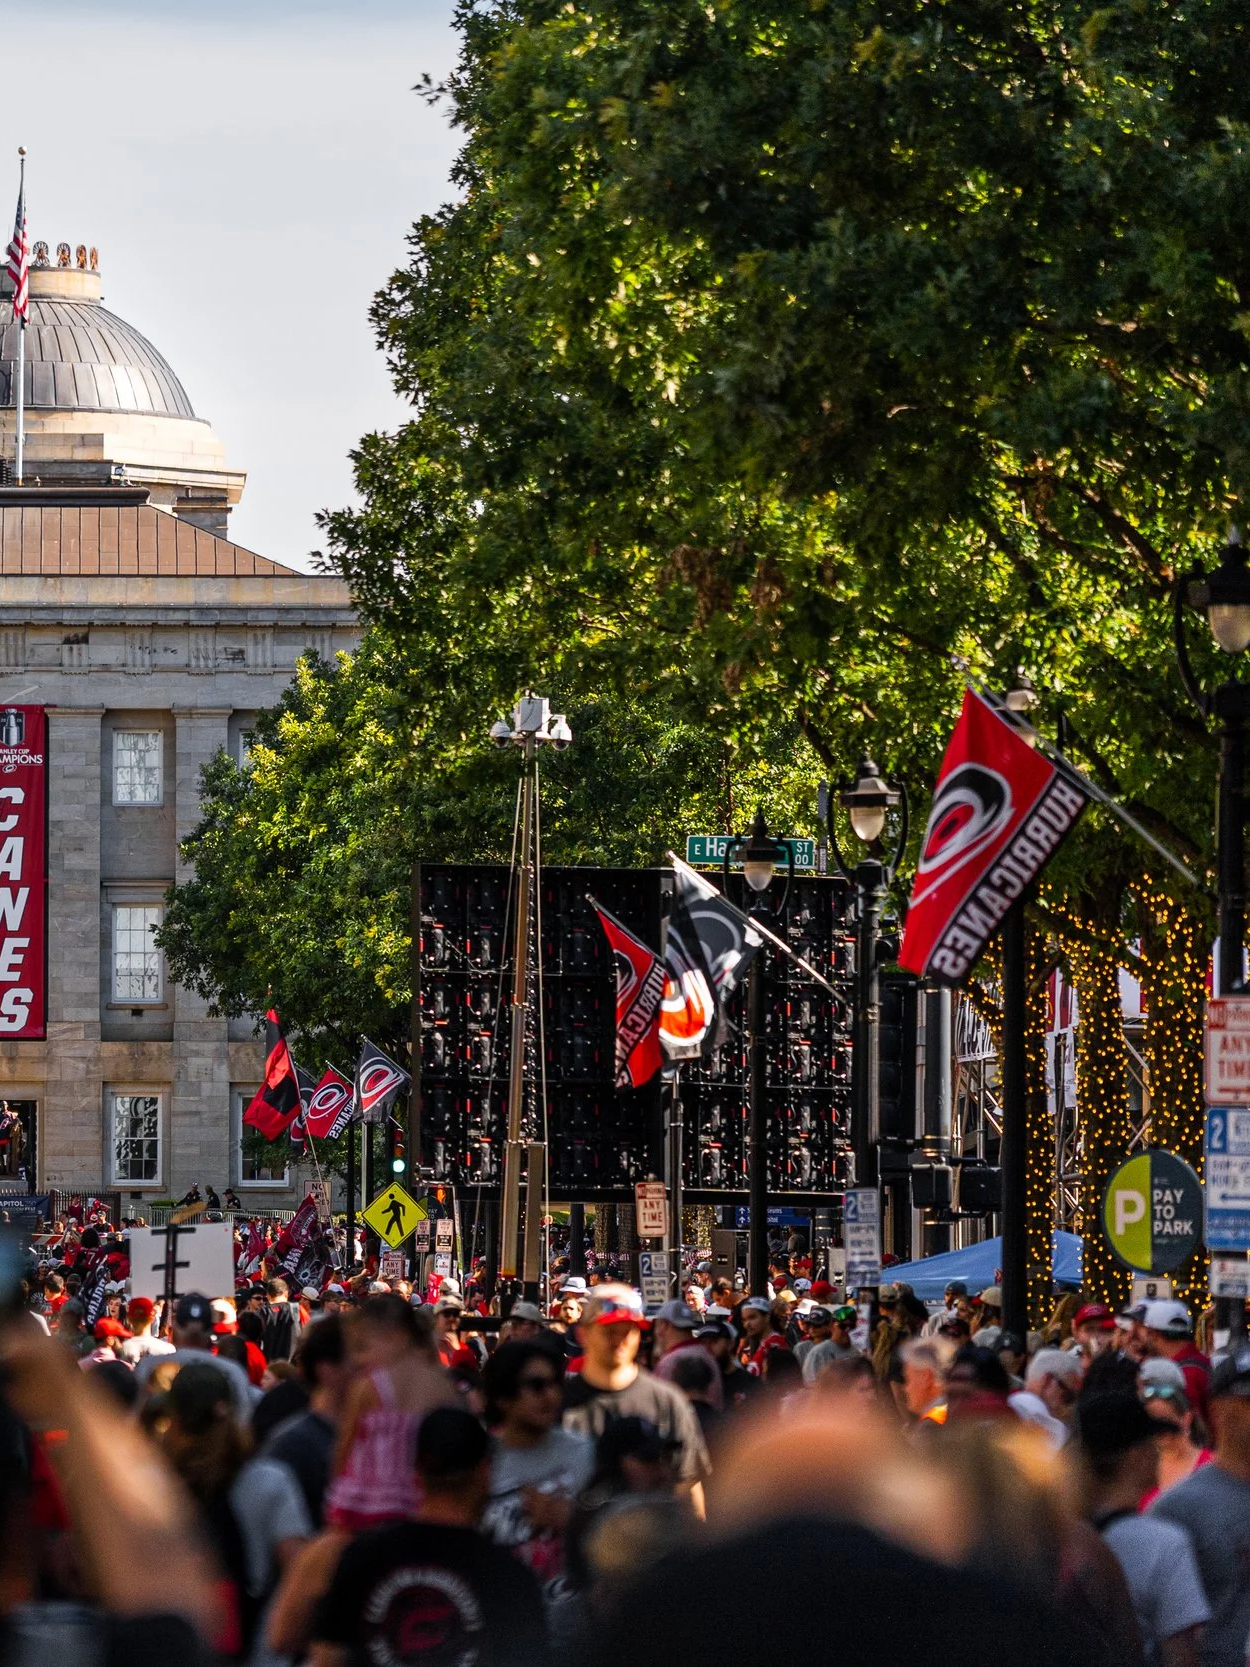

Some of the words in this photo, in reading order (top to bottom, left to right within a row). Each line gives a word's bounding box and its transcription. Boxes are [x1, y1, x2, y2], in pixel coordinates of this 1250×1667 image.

[694, 844, 701, 855] E
[796, 841, 809, 853] ST
[794, 854, 809, 865] 00
[1211, 1115, 1224, 1149] 2
[1153, 1189, 1184, 1204] PAY
[644, 1200, 660, 1209] ANY
[846, 1196, 857, 1219] 2
[642, 1212, 663, 1222] TIME
[1114, 1190, 1146, 1235] P
[1154, 1206, 1175, 1220] TO
[1153, 1221, 1193, 1236] PARK
[642, 1257, 651, 1274] 2
